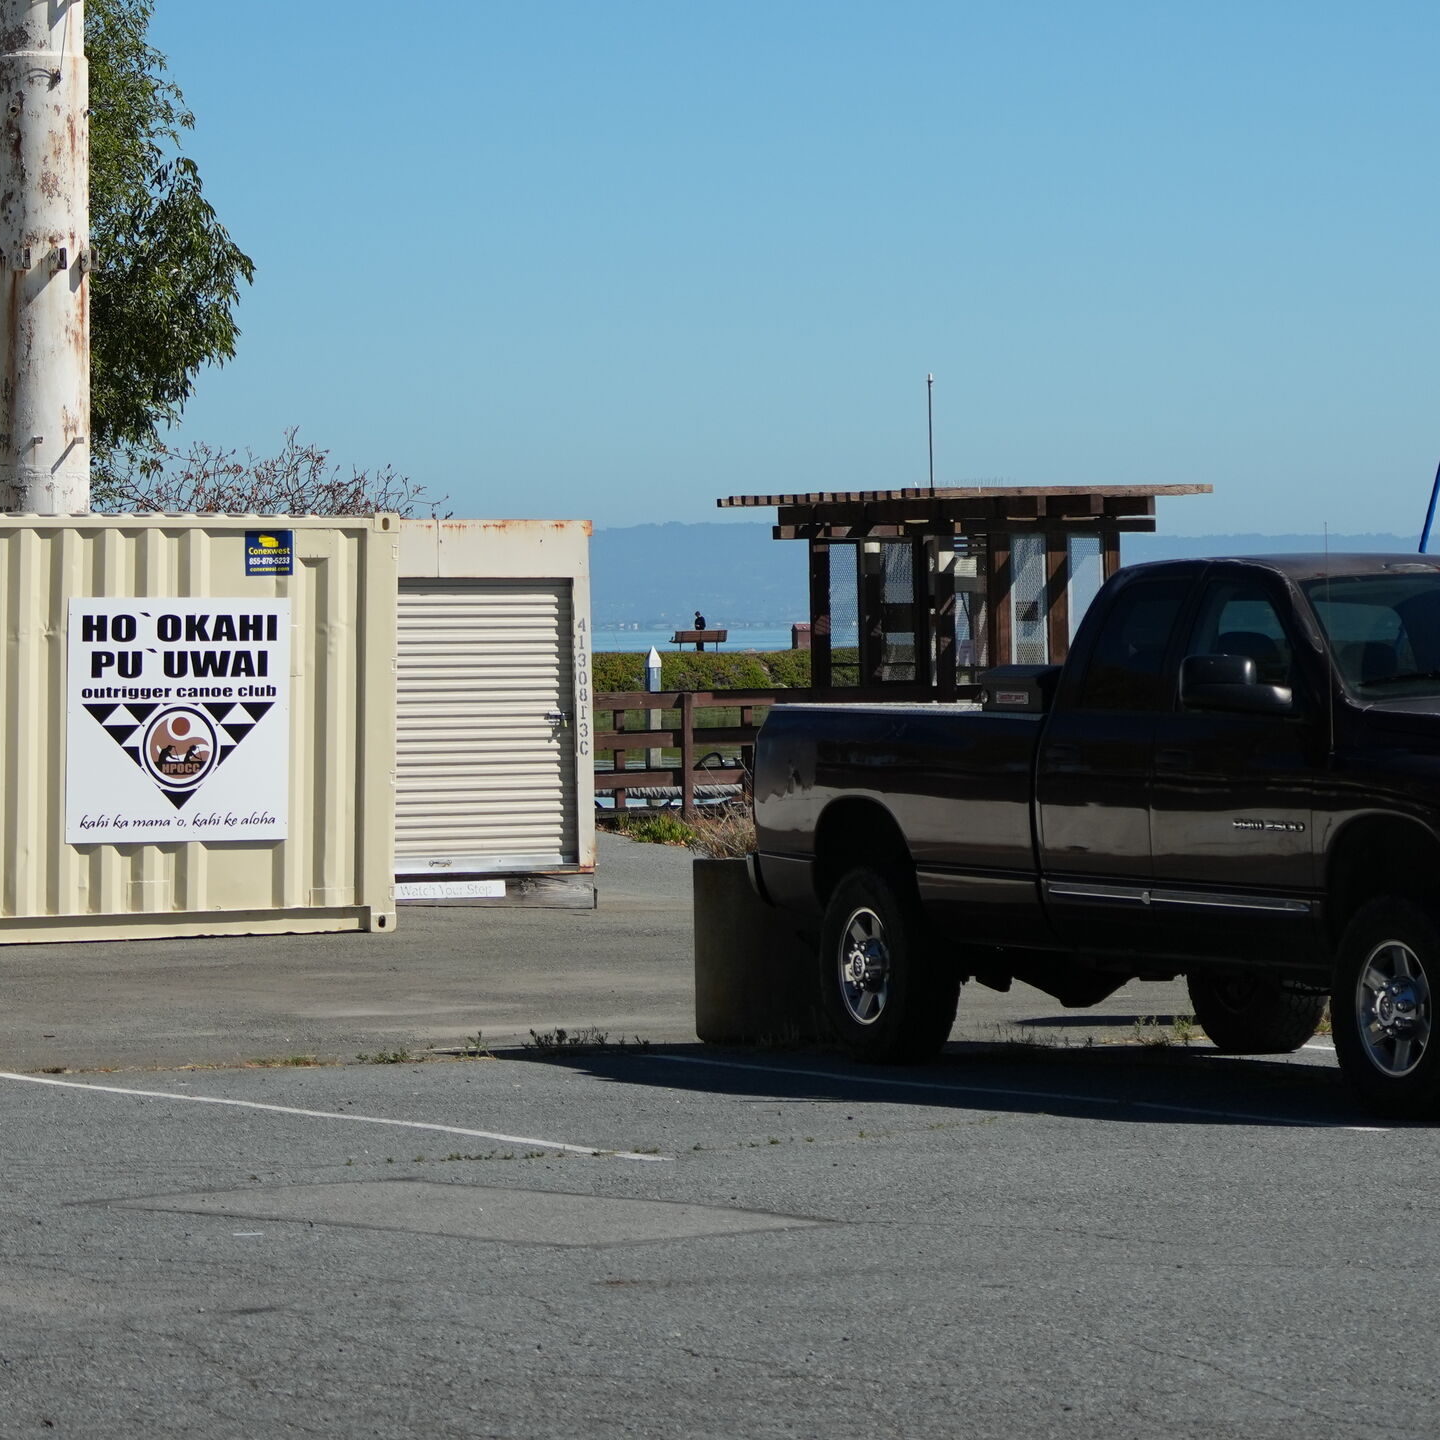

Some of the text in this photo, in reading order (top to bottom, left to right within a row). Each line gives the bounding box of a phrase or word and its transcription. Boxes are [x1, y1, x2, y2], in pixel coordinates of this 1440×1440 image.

[248, 547, 291, 555] Conexwest
[249, 556, 290, 565] 855-878-5233
[81, 684, 277, 700] outrigger canoe club
[162, 763, 200, 773] HPOCC
[79, 814, 110, 830] kahi
[112, 814, 129, 830] ka
[191, 812, 221, 826] kahi
[223, 812, 238, 826] ke
[240, 811, 276, 826] aloha
[400, 885, 436, 897] Watch
[466, 883, 493, 896] Step
